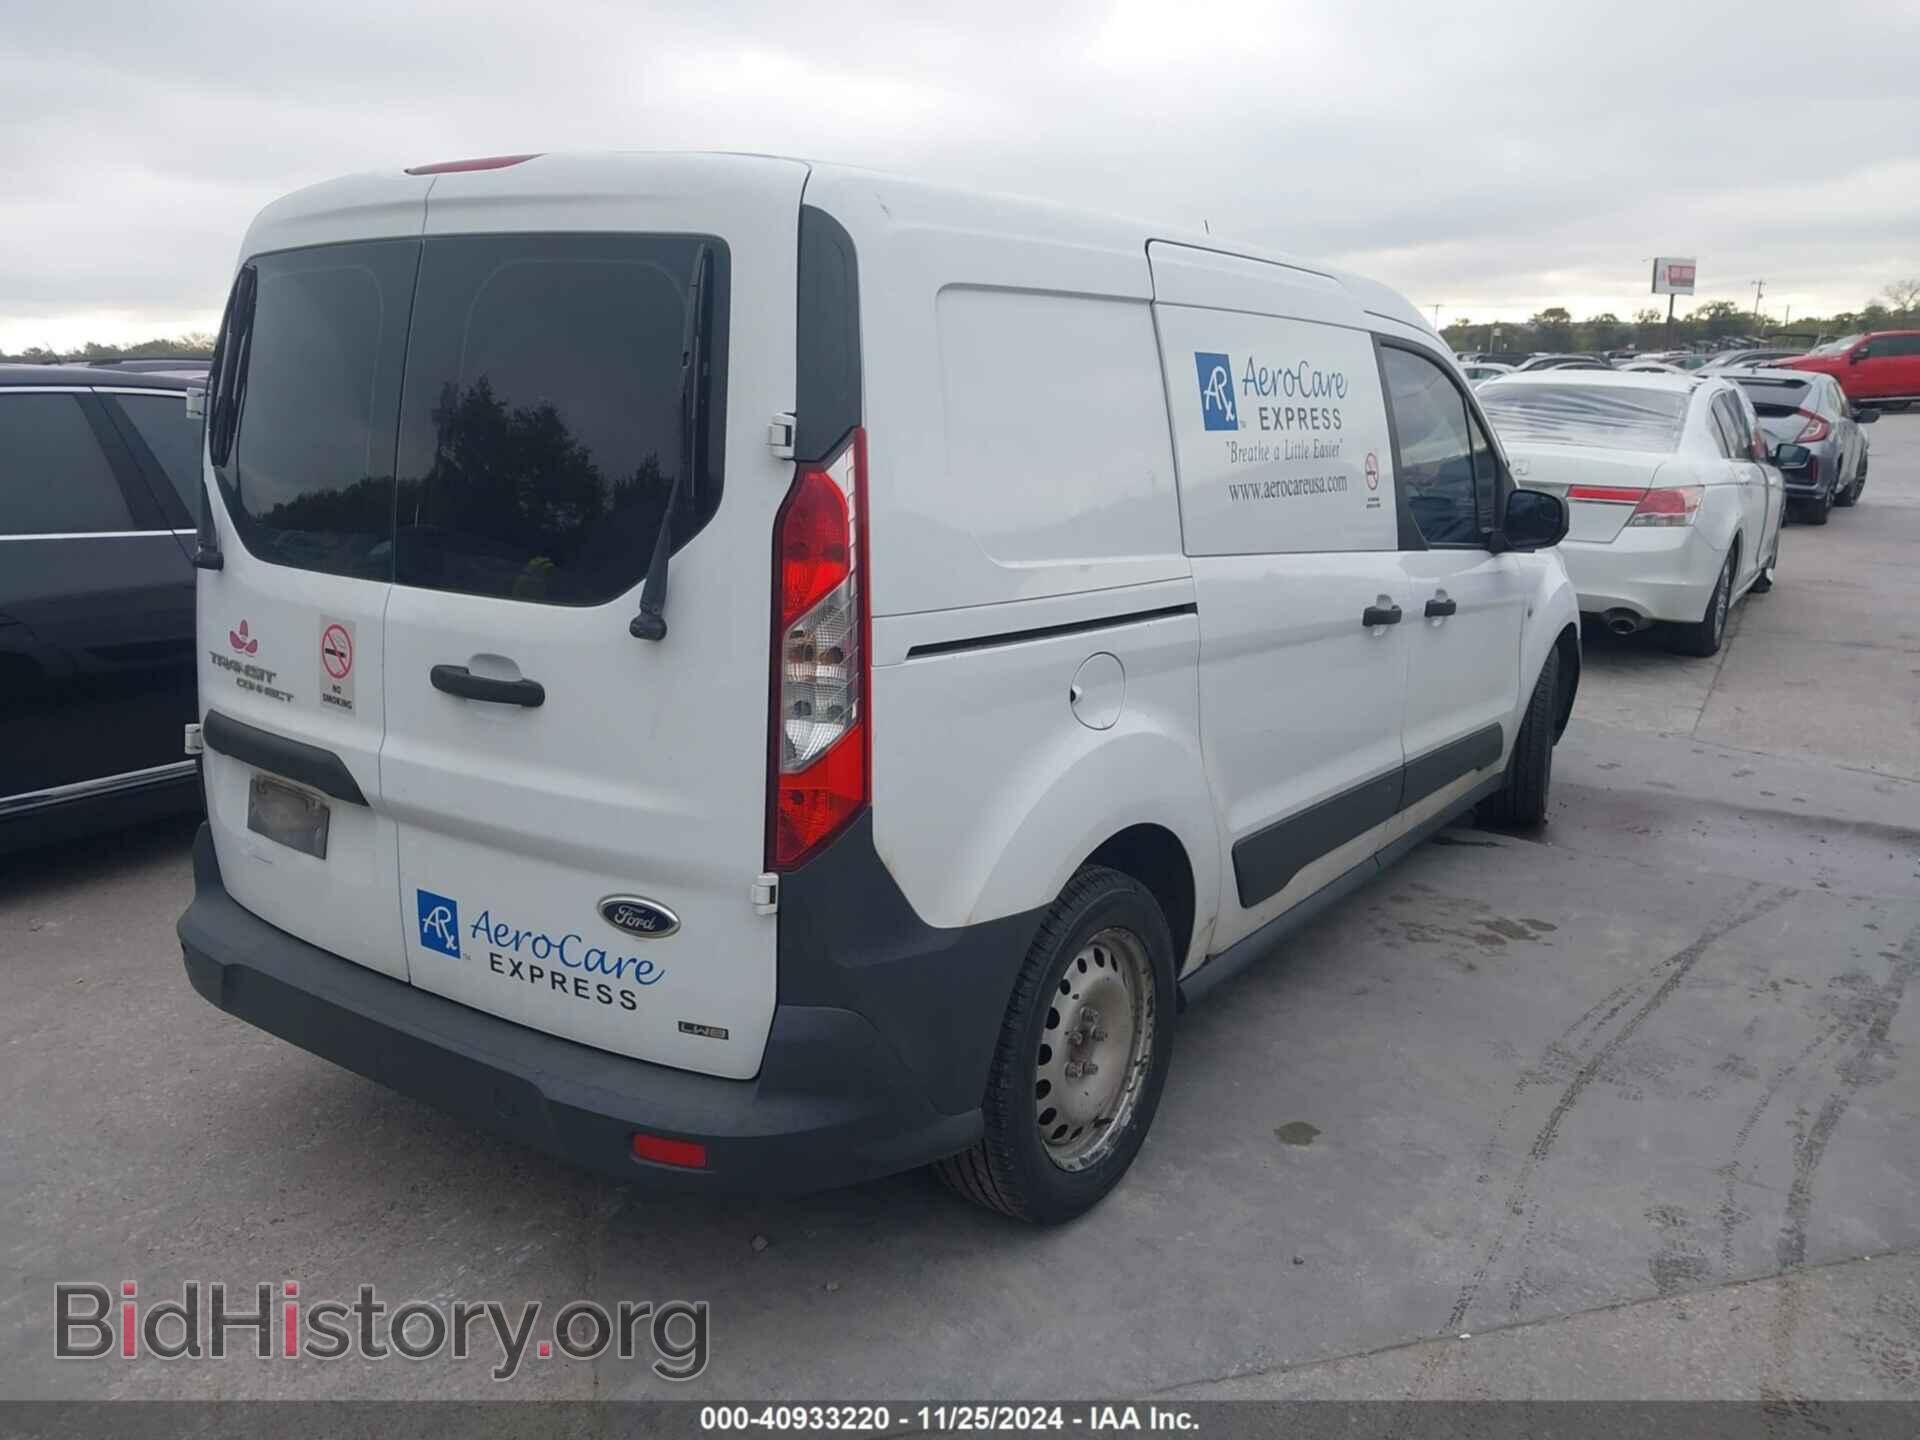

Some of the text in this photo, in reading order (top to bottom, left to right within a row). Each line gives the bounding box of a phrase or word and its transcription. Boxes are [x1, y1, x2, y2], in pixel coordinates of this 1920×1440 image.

[1242, 356, 1348, 399] AeroCare
[1258, 406, 1343, 431] EXPRESS
[1284, 439, 1309, 461] Little
[1228, 475, 1348, 501] www.aerocareusa.com
[614, 904, 656, 931] Ford
[470, 910, 666, 985] AeroCare
[489, 952, 637, 1011] EXPRESS
[679, 1022, 728, 1040] LWB
